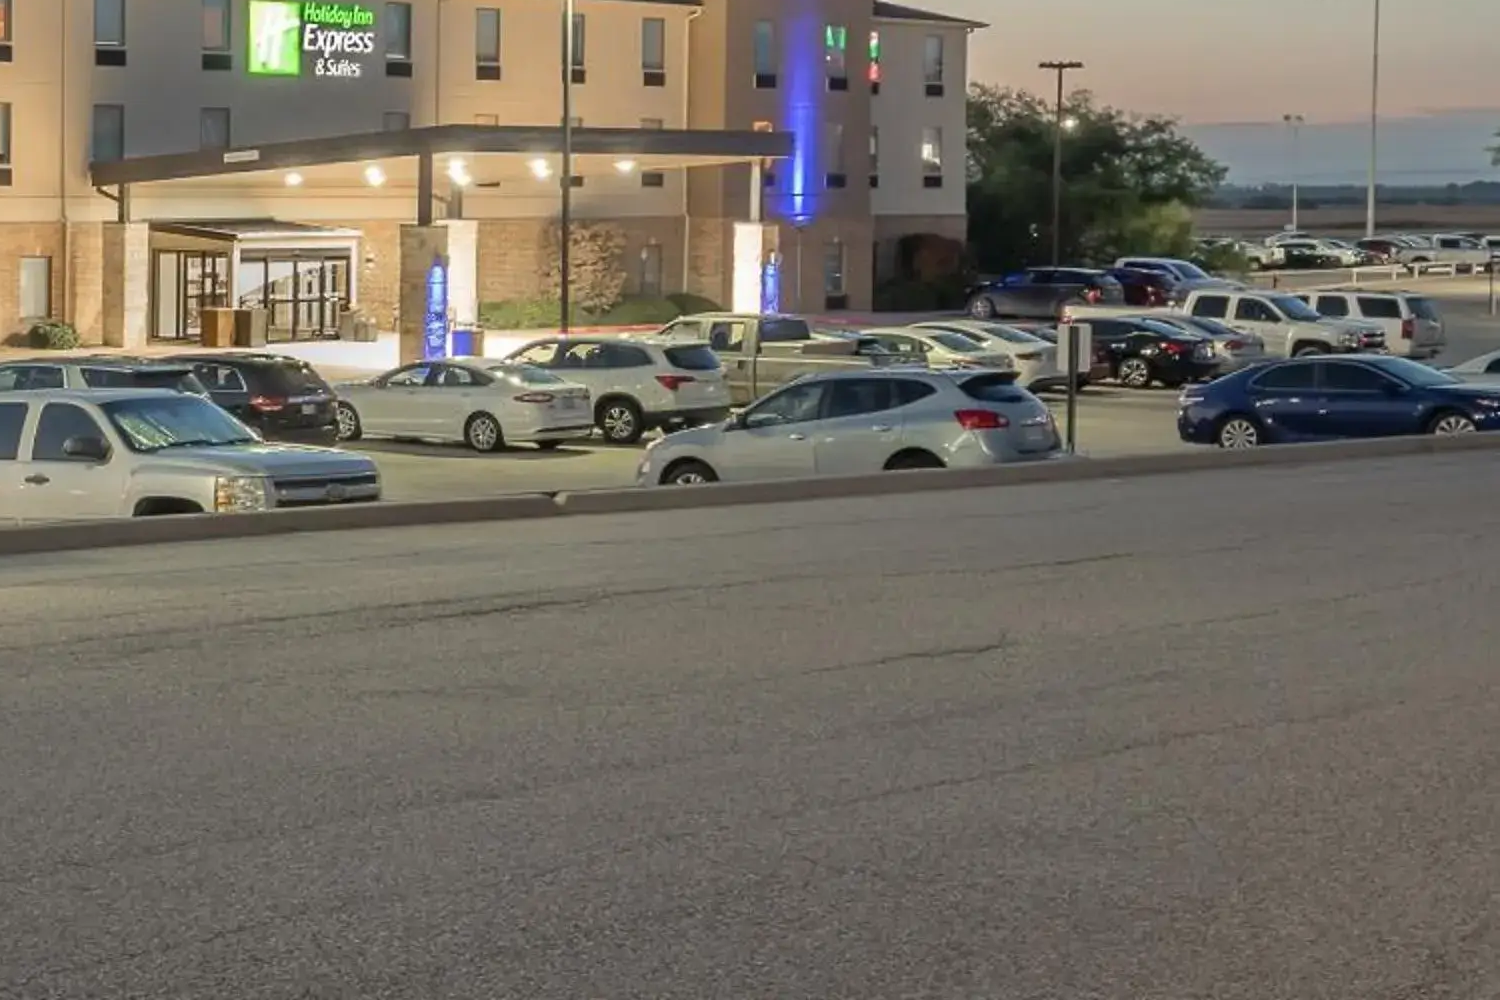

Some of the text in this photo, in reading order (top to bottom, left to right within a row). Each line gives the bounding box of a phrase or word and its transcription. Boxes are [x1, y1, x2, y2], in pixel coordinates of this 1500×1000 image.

[303, 2, 373, 28] Holiday Inn
[303, 23, 375, 57] Express
[315, 58, 362, 77] & Suites
